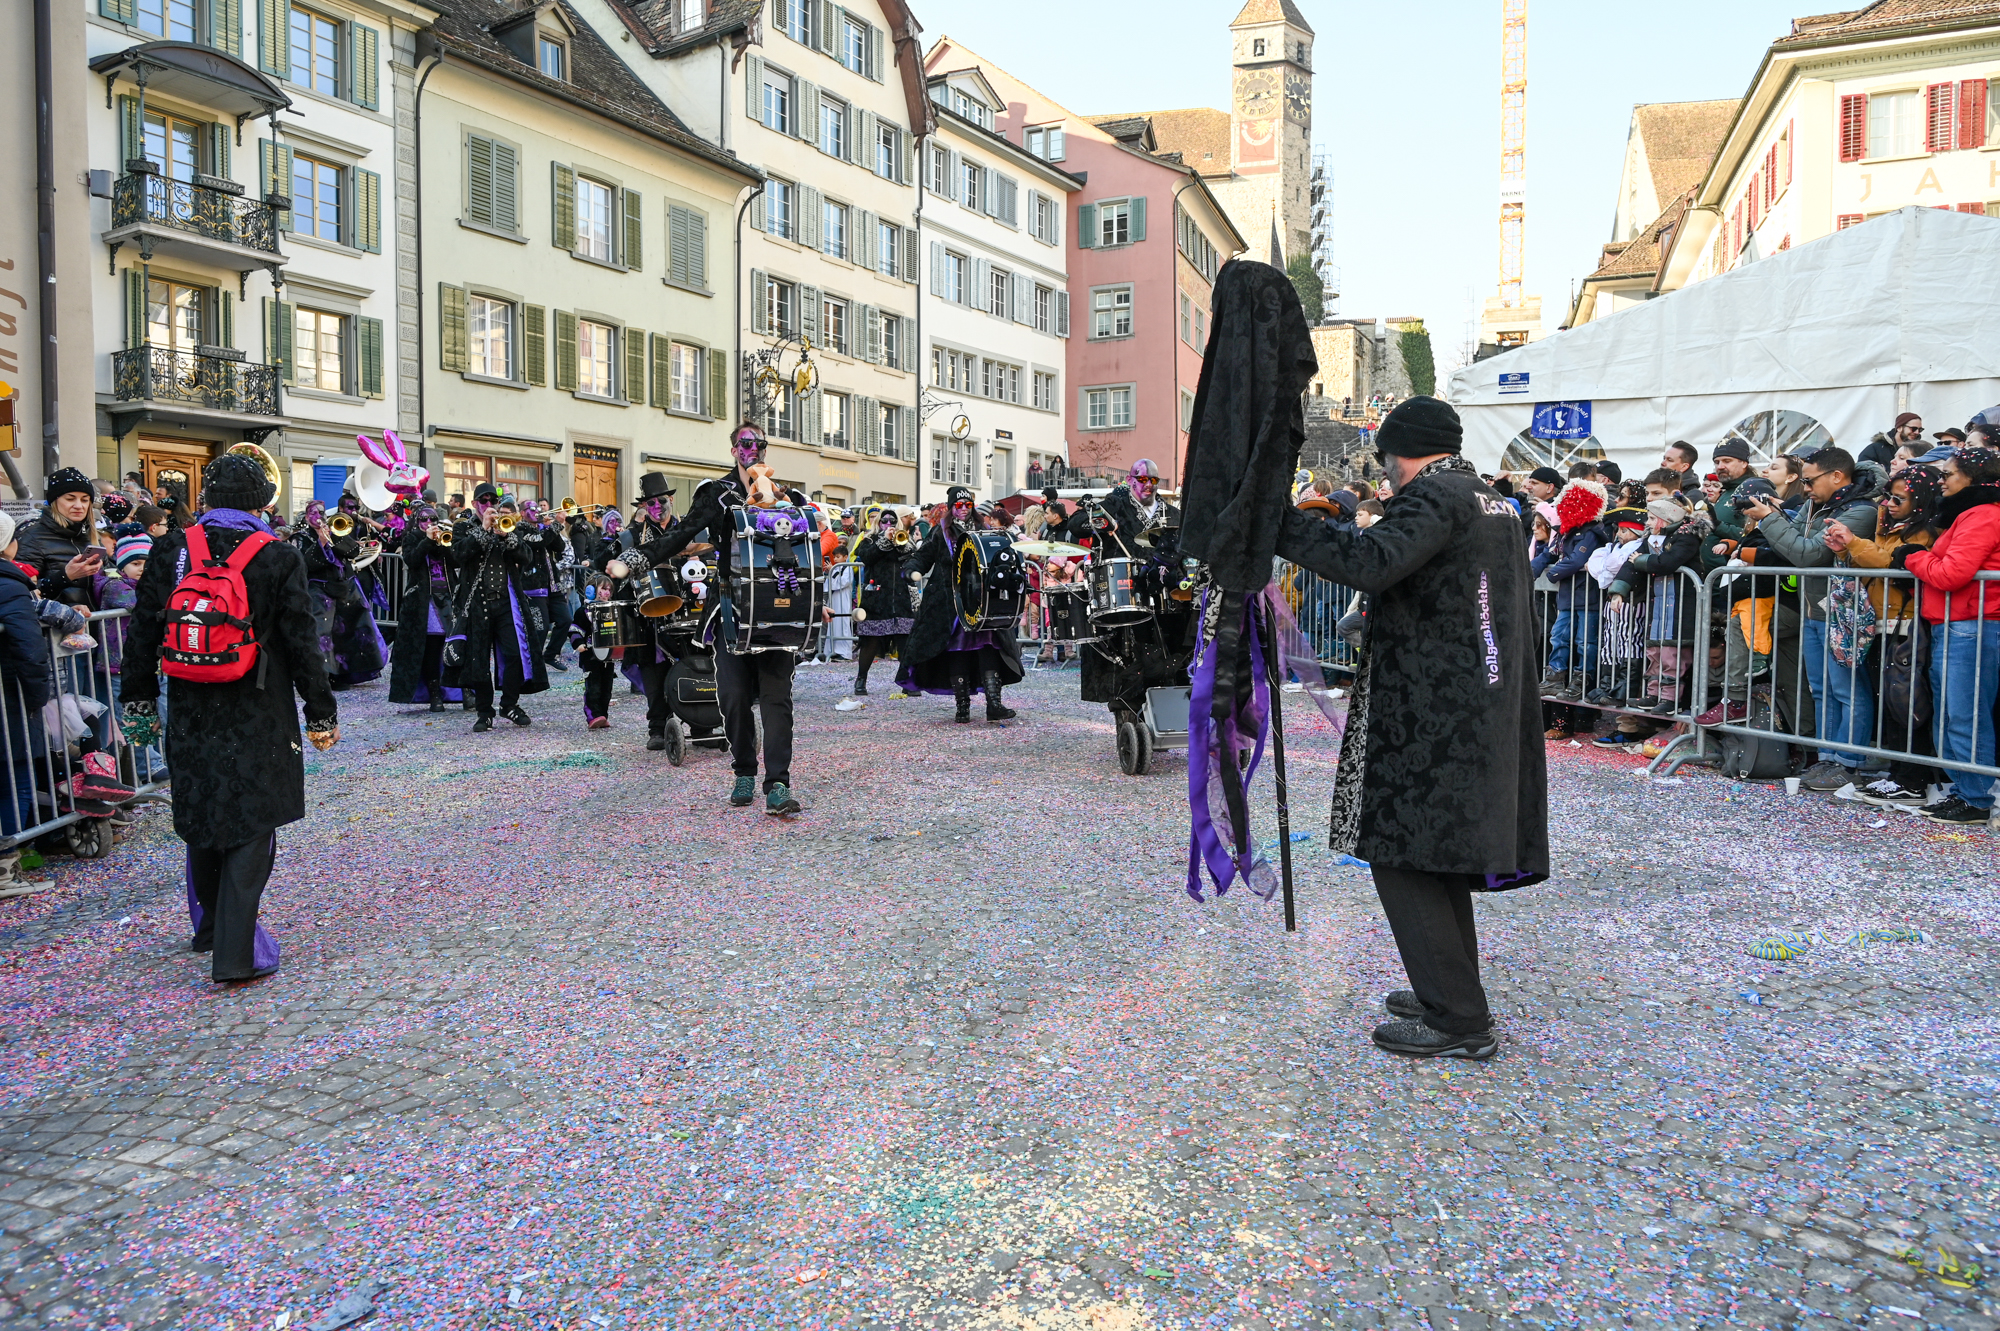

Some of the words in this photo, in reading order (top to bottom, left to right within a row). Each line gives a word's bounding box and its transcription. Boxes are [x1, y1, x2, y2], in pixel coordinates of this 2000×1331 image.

[1539, 425, 1583, 436] Kempraten
[818, 463, 860, 481] Falkenburg
[1477, 570, 1499, 685] Vollgashöckler
[187, 627, 199, 650] SPIRIT
